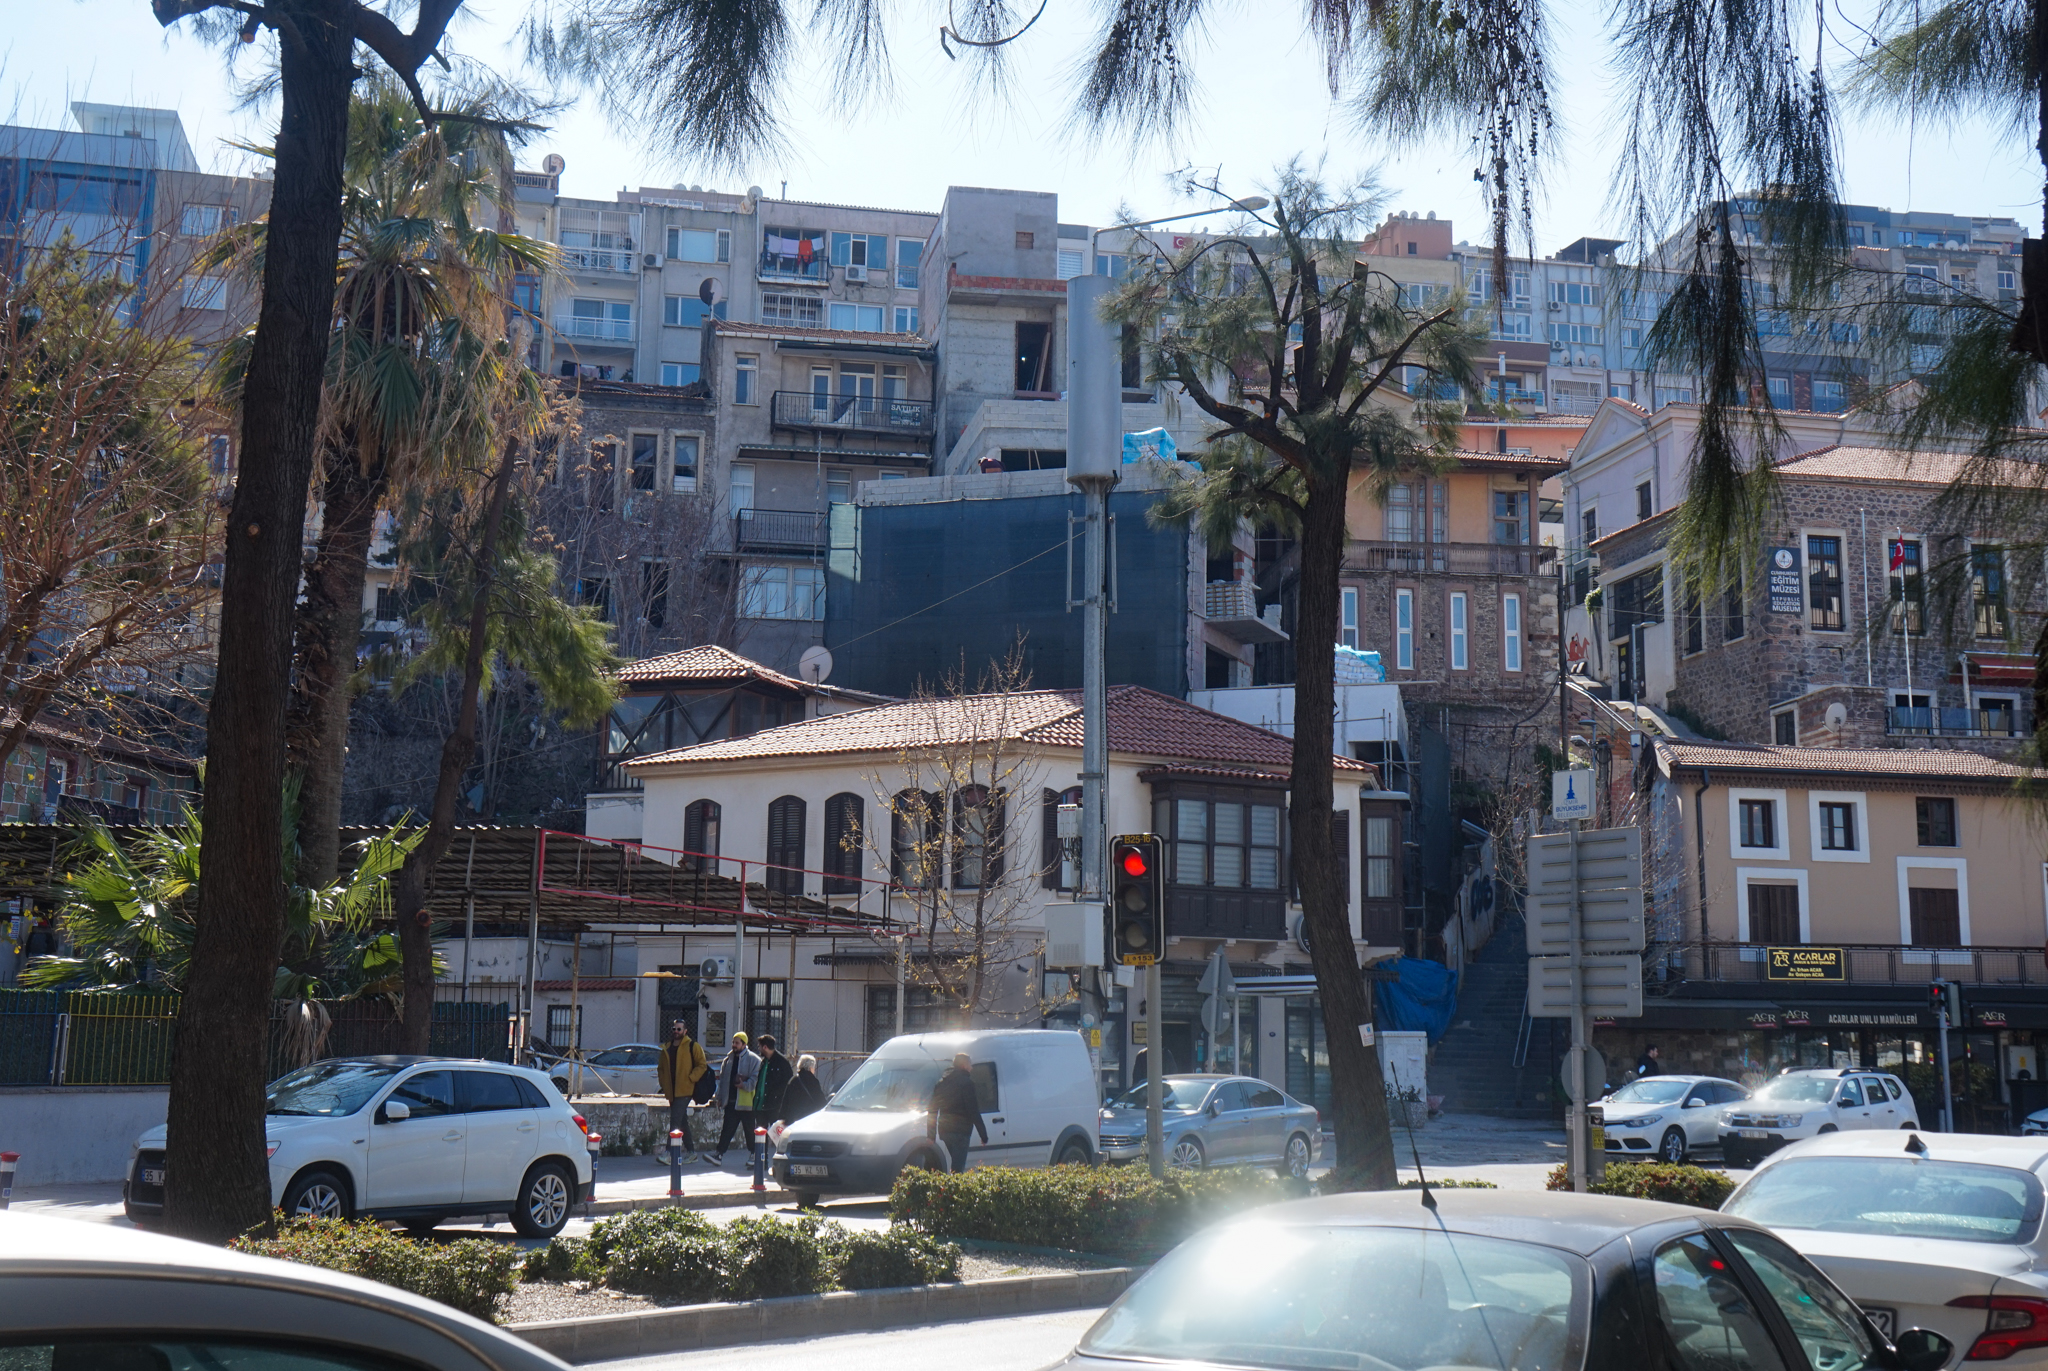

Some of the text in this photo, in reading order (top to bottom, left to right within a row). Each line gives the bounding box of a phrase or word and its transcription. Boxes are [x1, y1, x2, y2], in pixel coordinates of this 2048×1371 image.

[1772, 576, 1800, 585] EĞİTİM
[1771, 585, 1800, 594] MÜZESİ
[1124, 835, 1151, 844] B25-16
[1793, 952, 1836, 961] ACARLAR
[1828, 1013, 1918, 1025] ACARLAR UNLU MAMÜLLERİ
[794, 1165, 801, 1174] 35
[145, 1170, 154, 1181] 35
